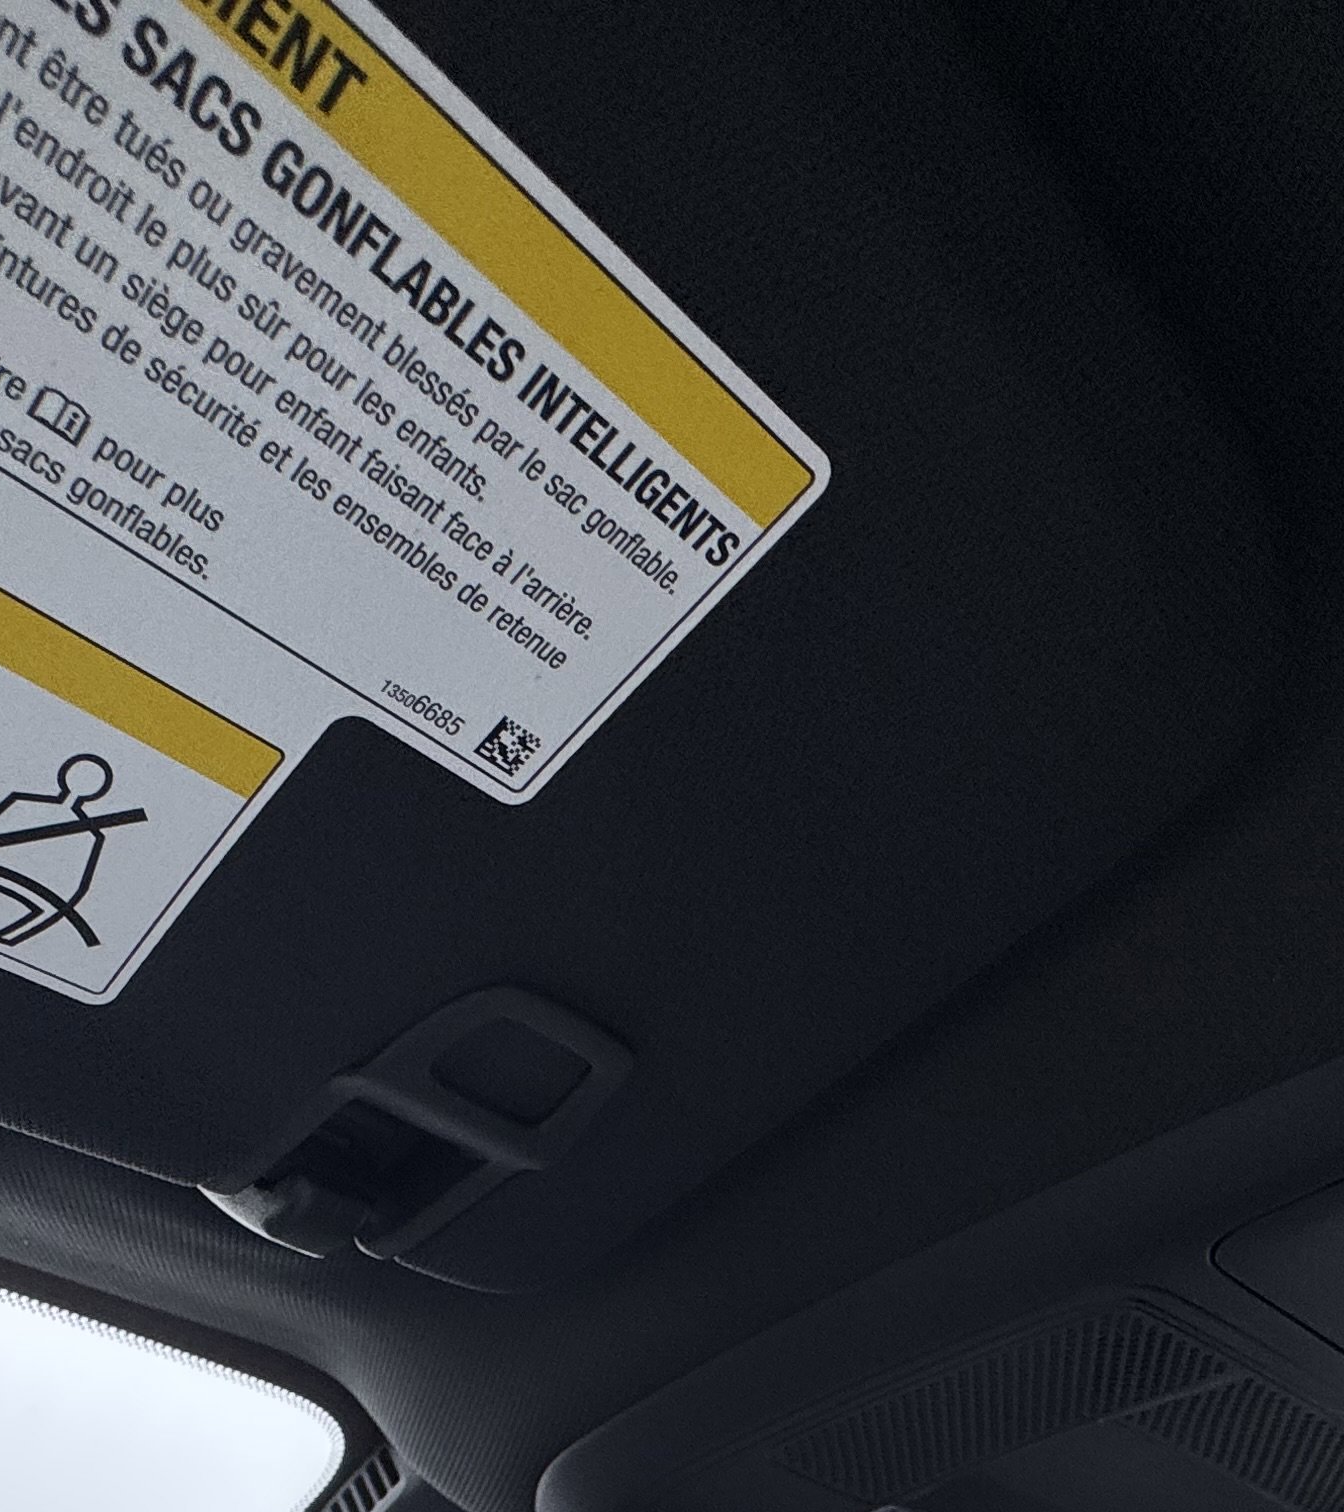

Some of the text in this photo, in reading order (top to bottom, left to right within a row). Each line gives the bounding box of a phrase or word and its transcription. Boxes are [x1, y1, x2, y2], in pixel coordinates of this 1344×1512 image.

[39, 48, 109, 126] être
[114, 110, 186, 188] tués
[189, 180, 232, 226] ou
[230, 218, 386, 351] gravement
[383, 334, 479, 427] blessés
[473, 419, 524, 459] par
[519, 448, 546, 481] le
[544, 474, 587, 515] sac
[581, 509, 678, 594] gonflable.
[75, 236, 118, 282] un
[122, 274, 204, 345] siège
[202, 337, 276, 394] pour
[275, 390, 362, 463] enfant
[360, 449, 445, 524] faisant
[442, 511, 493, 561] face
[492, 549, 513, 576] à
[510, 563, 592, 640] l'arrière.
[122, 16, 262, 157] SACS
[262, 139, 525, 382] GONFLABLES
[517, 364, 740, 566] INTELLIGENTS
[135, 204, 167, 247] le
[166, 239, 236, 302] plus
[238, 294, 291, 340] sûr
[285, 333, 356, 391] pour
[353, 378, 396, 426] les
[396, 420, 486, 502] enfants.
[66, 477, 208, 580] gonflables.
[92, 436, 165, 489] pour
[161, 483, 224, 531] plus
[101, 325, 141, 364] de
[145, 358, 261, 447] sécurité
[260, 441, 292, 472] et
[291, 457, 332, 500] les
[333, 494, 457, 590] ensembles
[457, 584, 488, 612] de
[487, 606, 566, 669] retenue
[380, 680, 465, 736] 13506685
